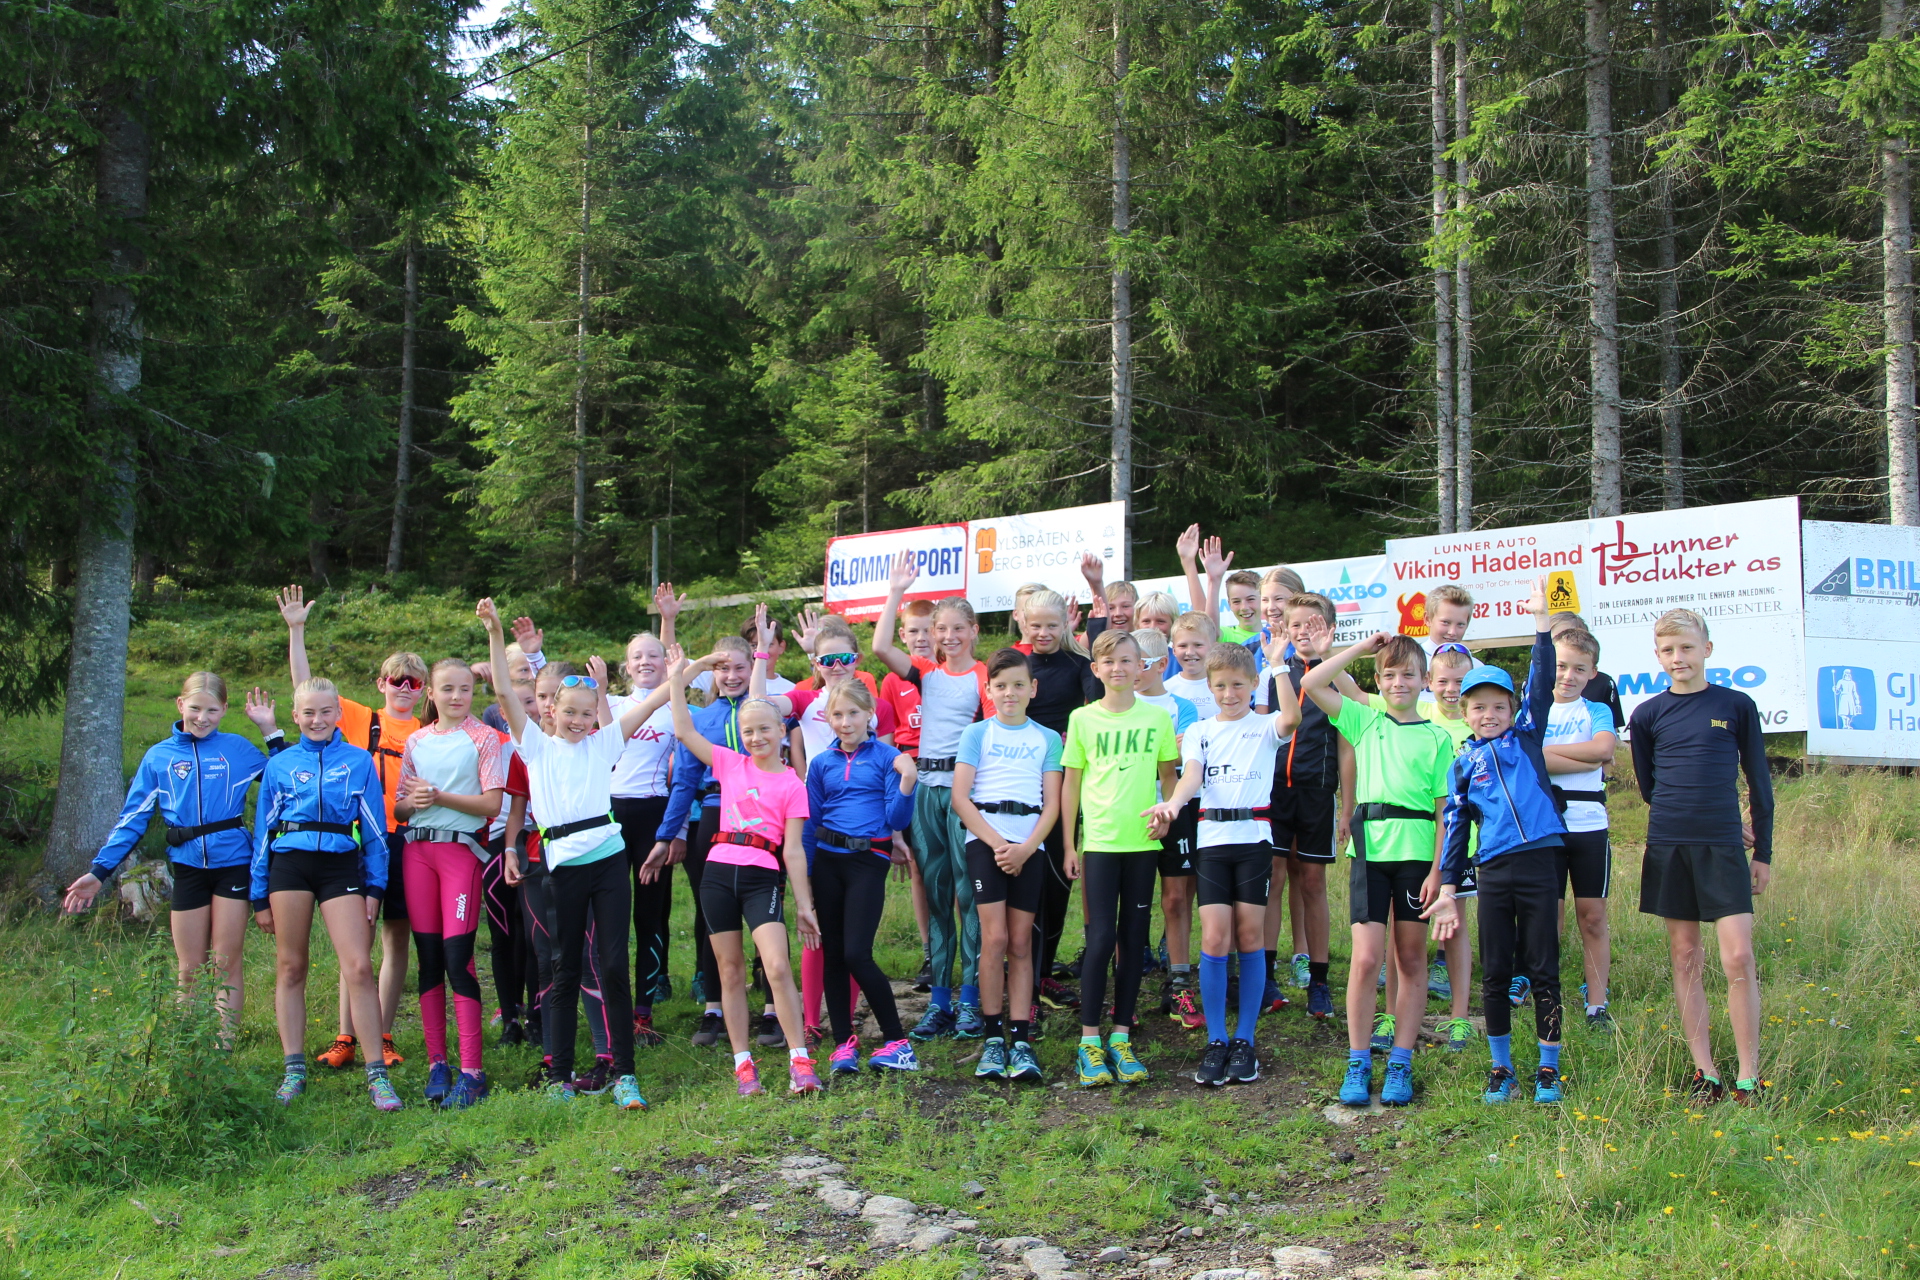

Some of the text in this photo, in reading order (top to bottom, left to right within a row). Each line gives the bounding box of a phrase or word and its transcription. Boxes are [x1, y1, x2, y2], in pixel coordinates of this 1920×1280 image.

[1075, 530, 1085, 543] &
[1434, 536, 1537, 555] LUNNER AUTO
[829, 553, 896, 587] GLØMM
[978, 549, 1090, 574] BERG BYGG A
[1394, 545, 1583, 580] Viking Hadeland
[1747, 556, 1781, 572] as
[996, 596, 1013, 606] 906
[1309, 583, 1387, 601] MAXBO
[1599, 601, 1610, 609] DIN
[1612, 597, 1653, 608] LEVERANDØR
[1666, 593, 1695, 603] PREMIER
[1697, 592, 1707, 601] TIL
[1709, 590, 1735, 600] ENHVER
[1738, 586, 1775, 597] ANLEDNING
[1472, 602, 1490, 618] 32
[1494, 601, 1512, 616] 13
[1550, 601, 1573, 609] NAF
[1335, 618, 1363, 627] ROFF
[1404, 625, 1430, 635] VIKIN
[1618, 665, 1767, 696] MABO
[1887, 672, 1920, 707] GJ
[1889, 709, 1920, 732] Ha
[1096, 728, 1157, 759] NIKE
[1177, 837, 1190, 855] 11
